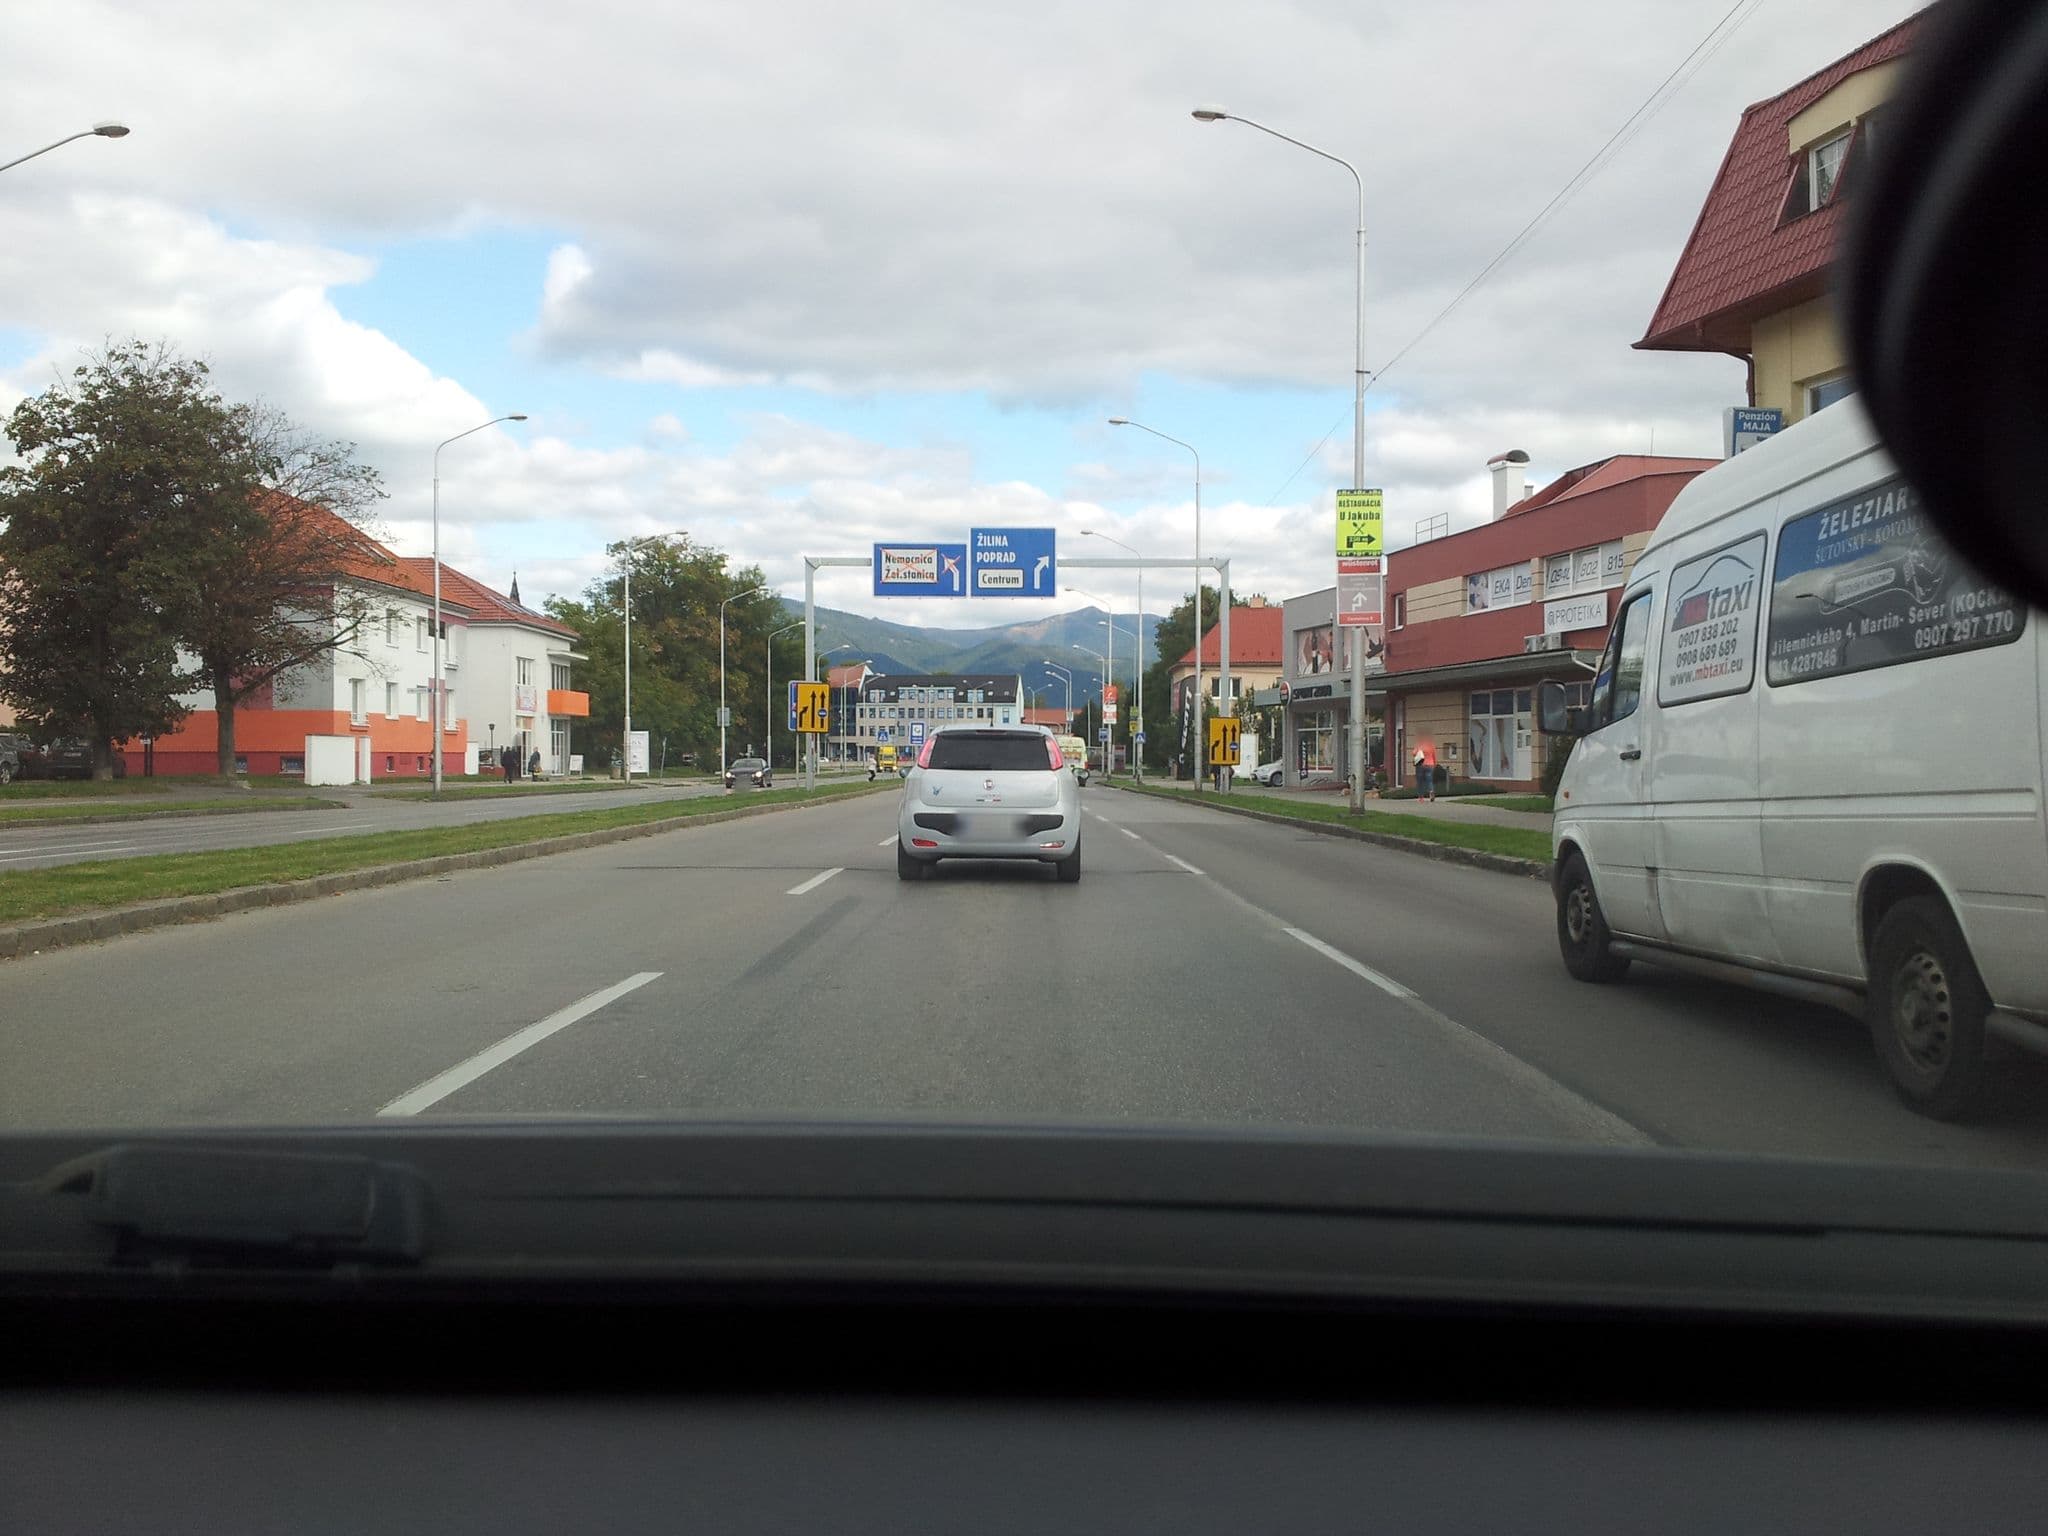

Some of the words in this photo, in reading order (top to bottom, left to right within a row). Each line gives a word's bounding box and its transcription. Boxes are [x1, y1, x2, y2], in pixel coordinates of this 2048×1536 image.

[1739, 411, 1776, 421] Penzión
[1743, 422, 1770, 431] MAJA
[1340, 511, 1345, 520] U
[1348, 511, 1380, 520] Jakuba
[976, 533, 1008, 547] ŽILINA
[885, 553, 933, 565] Nemocnica
[976, 551, 1016, 563] POPRAD
[982, 573, 1019, 584] Centrum
[1556, 605, 1602, 624] PROTETIKA
[1678, 629, 1700, 649] 0907
[1701, 623, 1719, 642] 838
[1720, 617, 1739, 636] 202
[1771, 629, 1842, 656] Jilemnického
[1908, 602, 1945, 625] Sever
[1914, 623, 1948, 649] 0907
[1953, 616, 1980, 642] 297
[1985, 609, 2014, 635] 770
[1676, 648, 1697, 668] 0908
[1700, 643, 1717, 662] 689
[1719, 638, 1737, 657] 689
[1791, 647, 1837, 675] 4287846
[1670, 658, 1743, 687] www.mbtaxi.eu
